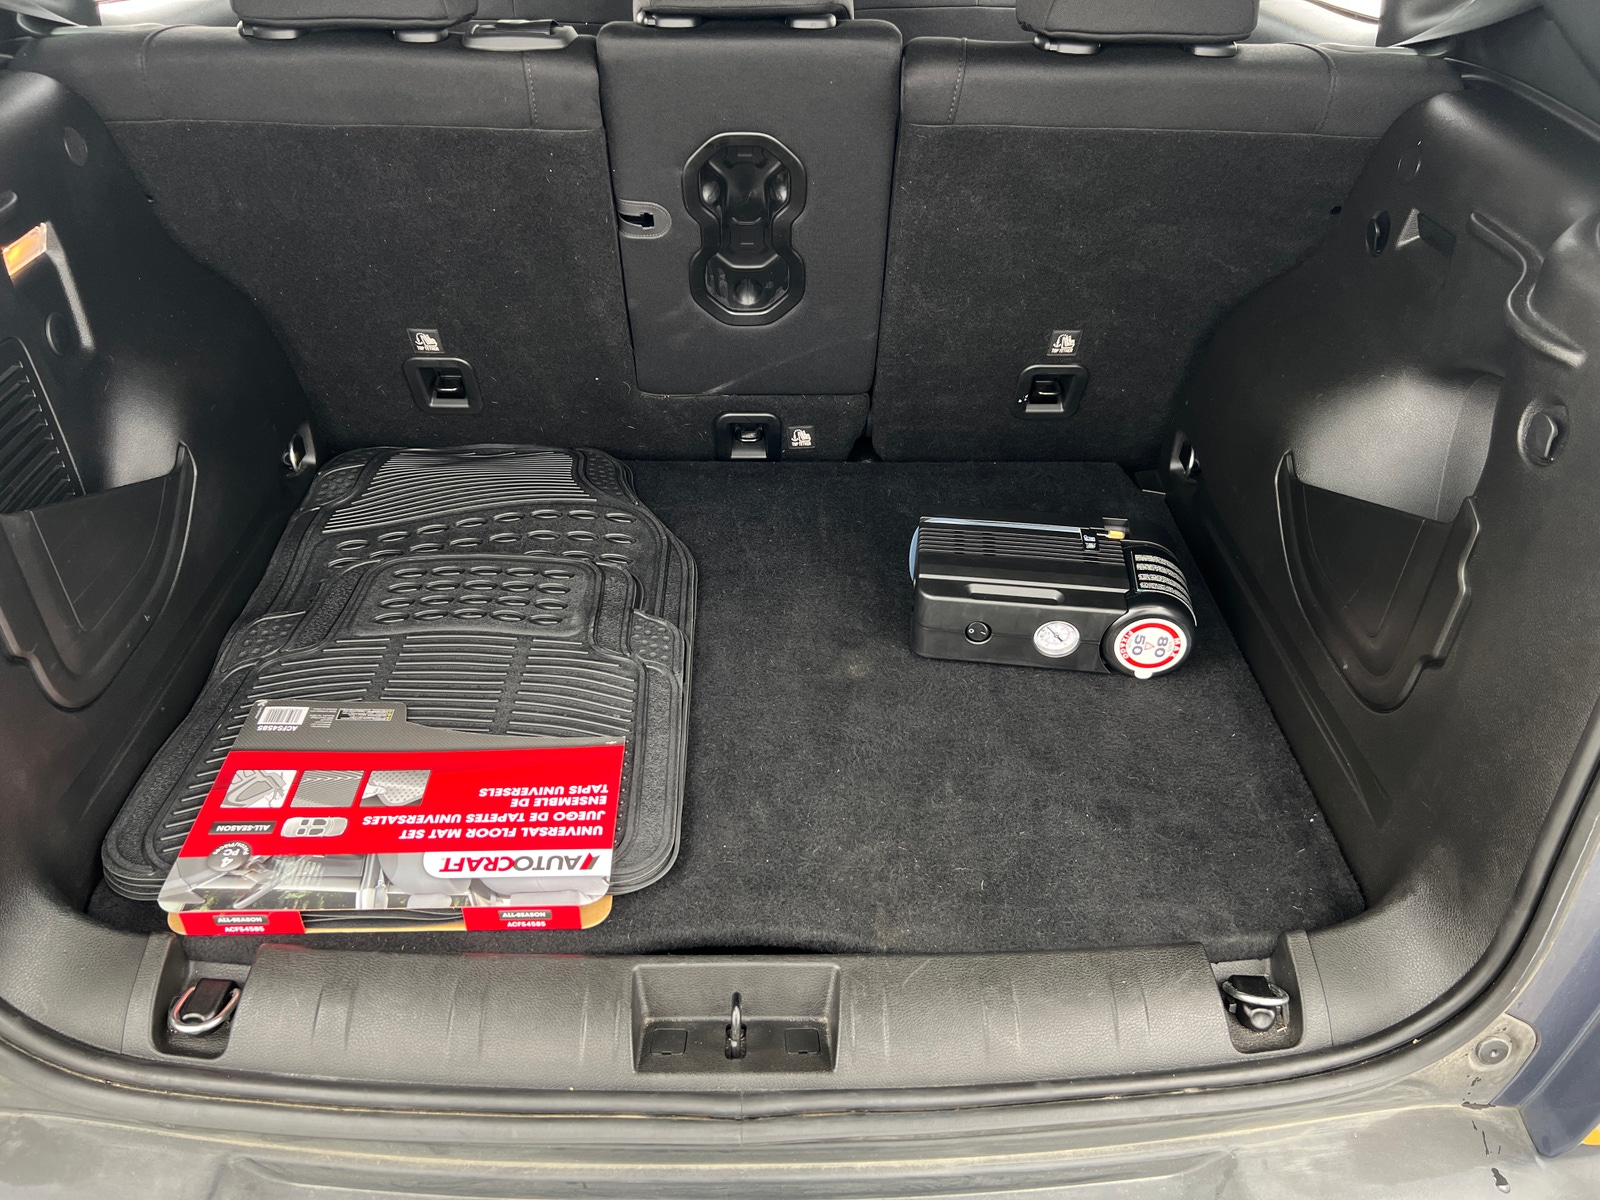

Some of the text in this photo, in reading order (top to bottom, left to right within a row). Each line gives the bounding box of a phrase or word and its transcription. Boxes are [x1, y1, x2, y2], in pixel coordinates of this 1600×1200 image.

[1131, 634, 1146, 656] 50
[1154, 636, 1169, 658] 80
[478, 784, 609, 797] TAPIS UNIVERSELS
[510, 795, 607, 807] ENSEMBLE DE
[362, 811, 606, 825] JUEGO DE TAPETES UNIVERSALES
[215, 824, 271, 832] ALL-SEASON
[398, 826, 604, 840] UNIVERSAL FLOOR MAT SET
[222, 848, 240, 856] PC
[220, 857, 233, 868] 4
[439, 855, 583, 873] AUTOCRAFT
